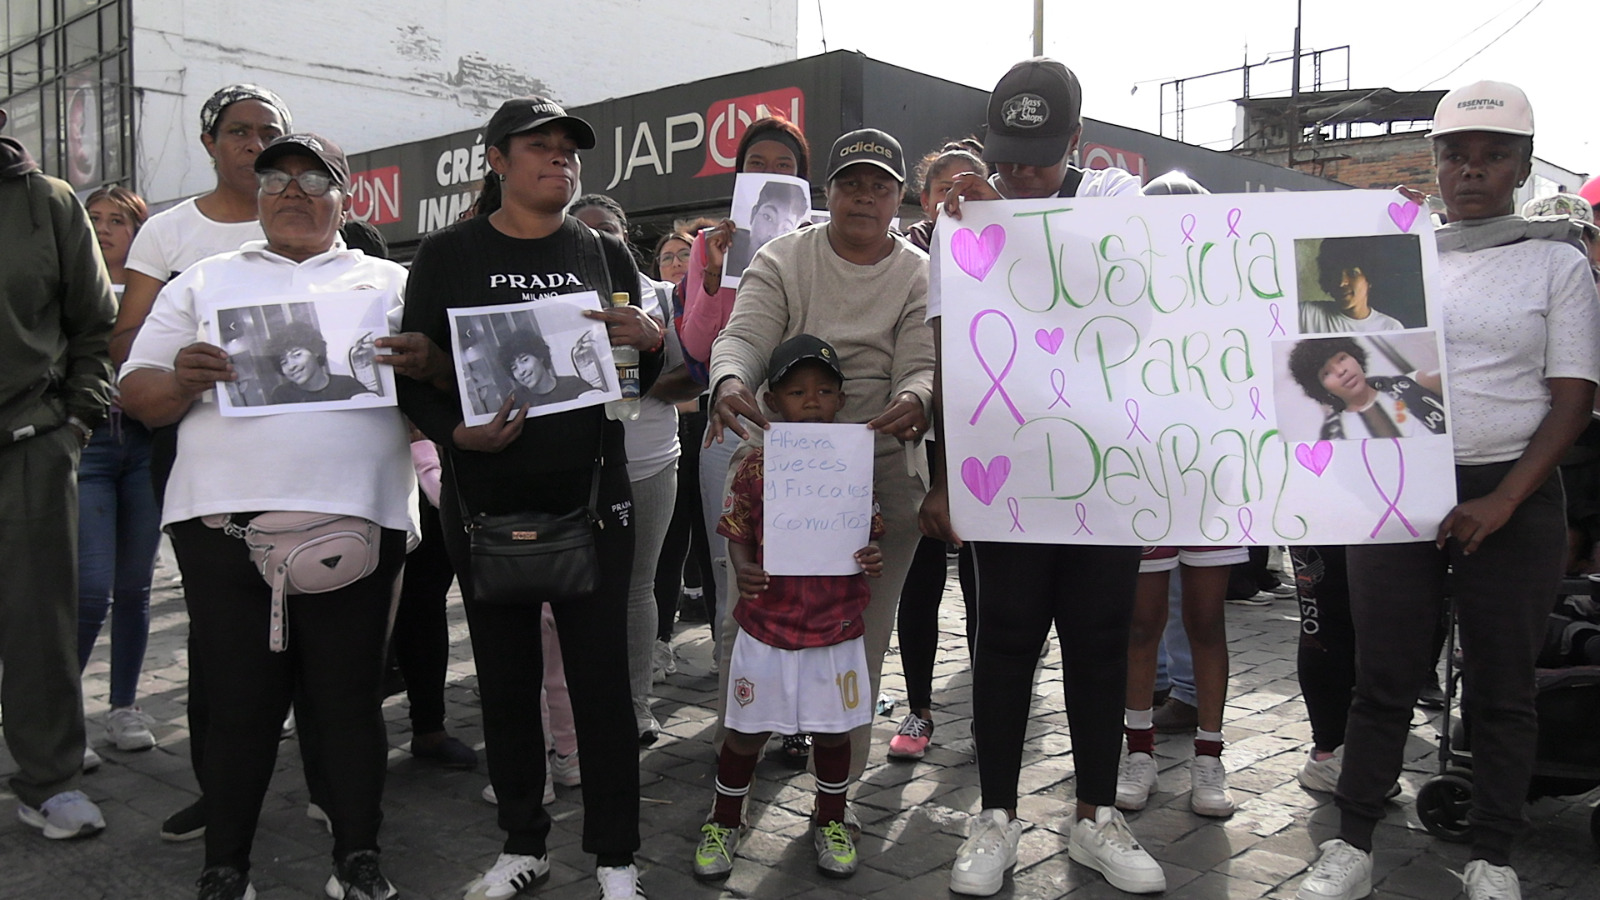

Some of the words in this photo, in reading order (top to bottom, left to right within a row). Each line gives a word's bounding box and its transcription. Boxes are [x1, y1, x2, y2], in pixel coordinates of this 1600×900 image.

[1021, 105, 1037, 116] Pro
[1022, 97, 1041, 107] Bass
[1457, 99, 1504, 109] ESSENTIALS
[1020, 114, 1043, 123] Shops
[840, 141, 893, 159] adidas
[436, 134, 491, 186] CRÉ
[418, 191, 480, 234] INM
[1008, 208, 1284, 314] Justicia
[490, 273, 583, 289] PRADA
[770, 429, 835, 449] Afuera
[766, 454, 848, 472] Jueces
[785, 478, 869, 498] Fiscales
[836, 670, 859, 712] 10
